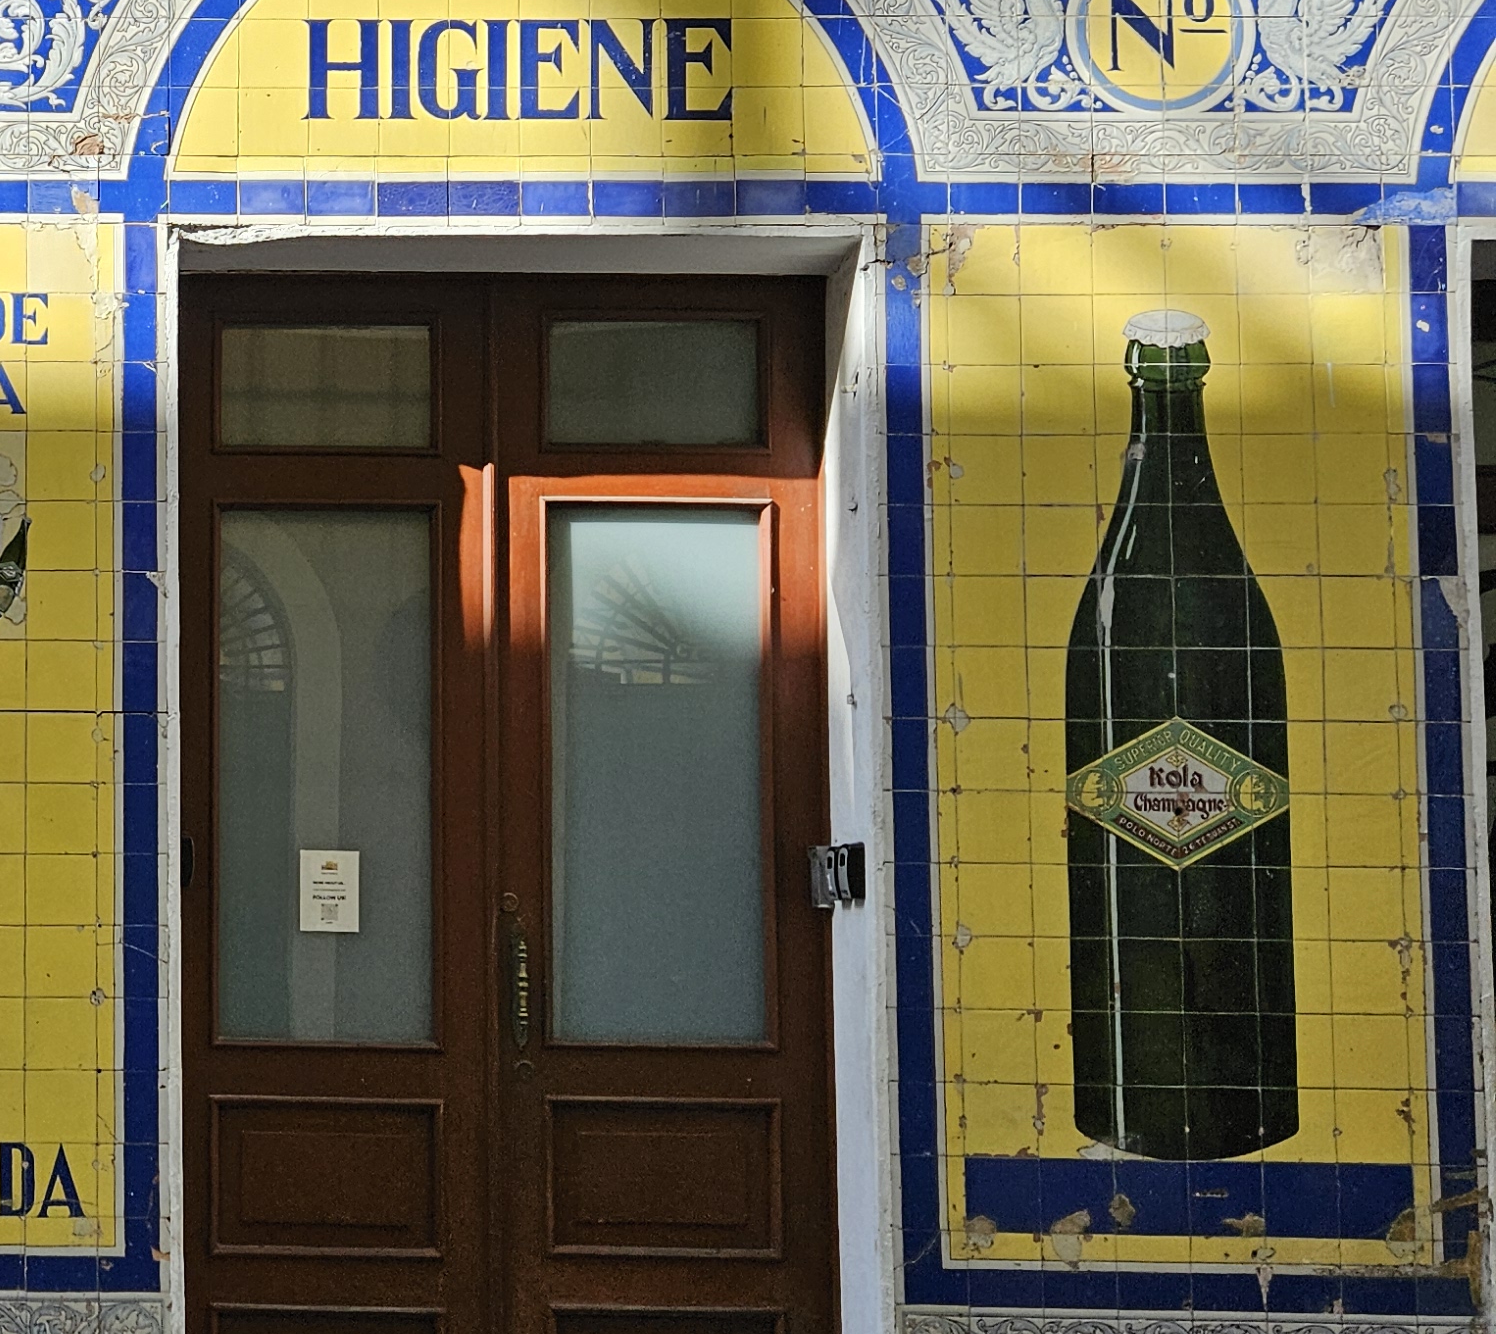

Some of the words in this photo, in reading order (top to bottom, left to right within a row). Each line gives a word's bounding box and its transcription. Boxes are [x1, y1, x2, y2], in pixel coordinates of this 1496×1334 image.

[301, 18, 732, 120] HIGIENE
[1114, 730, 1175, 771] SUPERIOR
[1179, 729, 1242, 773] QUALITY
[1148, 764, 1204, 789] Kola
[1119, 817, 1146, 837] POLO
[1146, 833, 1178, 856] NORTE
